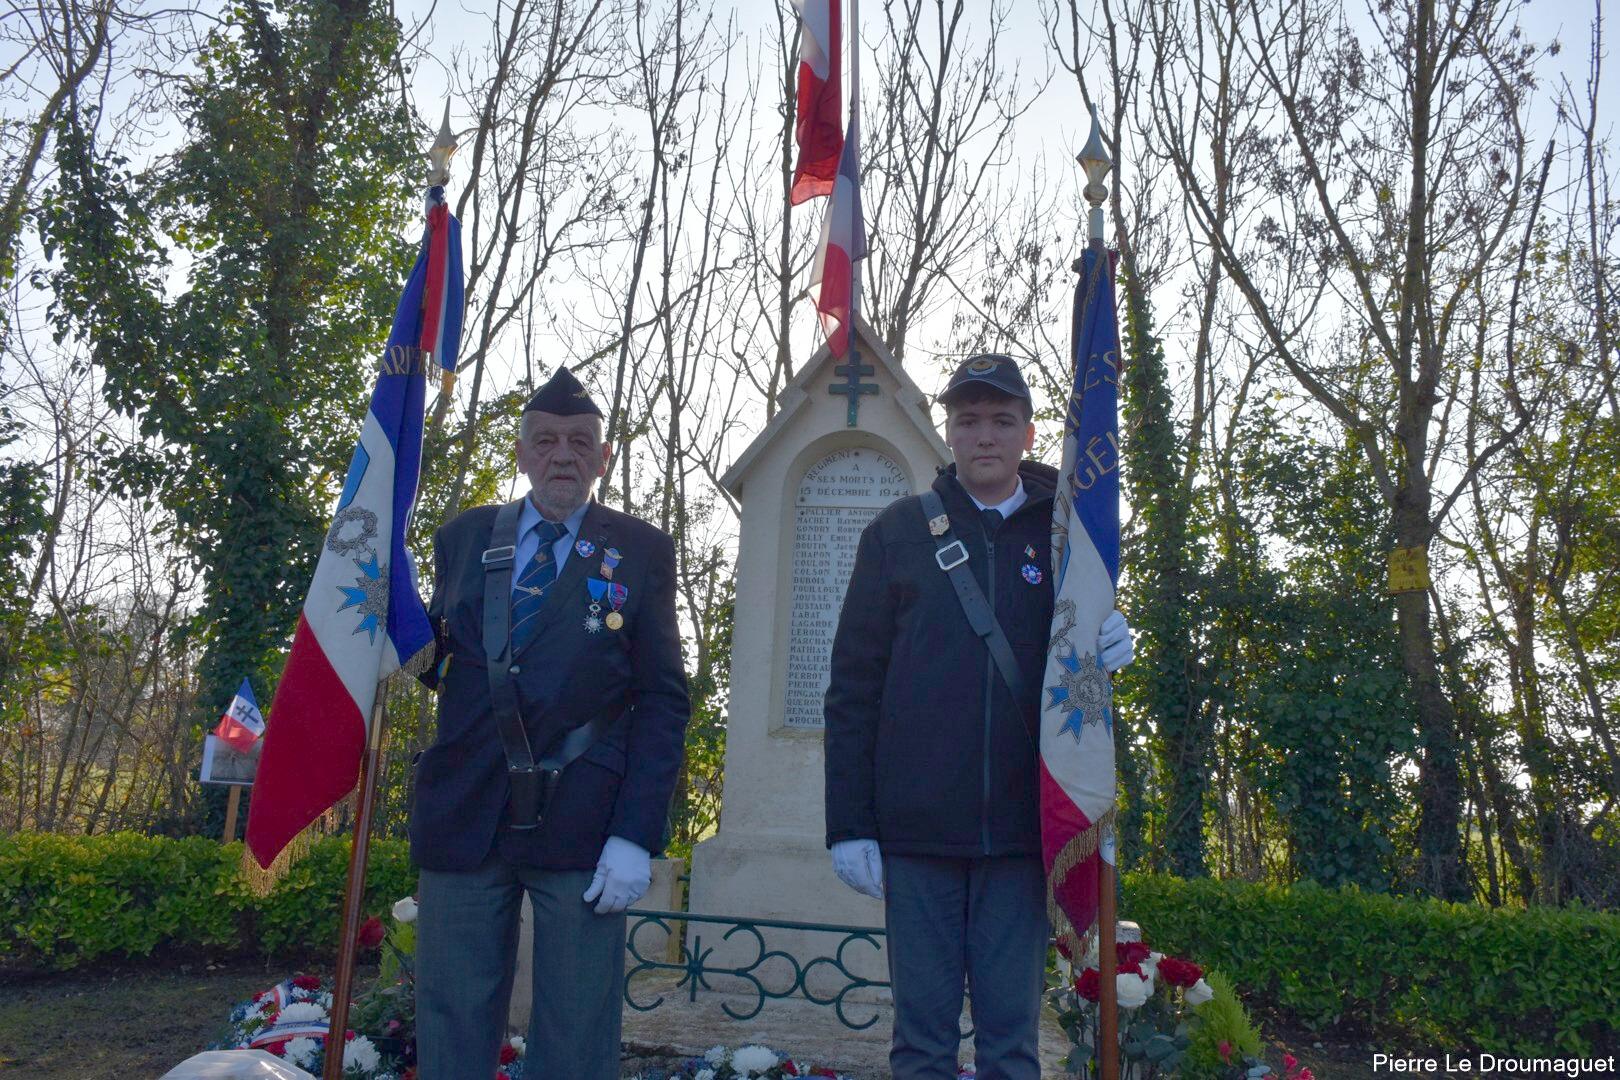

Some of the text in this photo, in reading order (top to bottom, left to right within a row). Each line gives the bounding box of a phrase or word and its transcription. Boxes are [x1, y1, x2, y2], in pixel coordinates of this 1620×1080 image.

[877, 455, 905, 482] FOCH
[817, 475, 896, 485] SES MORTS DU
[879, 488, 909, 496] 1944
[806, 509, 841, 517] PALLIER
[791, 629, 826, 637] LEROUX
[789, 655, 828, 663] PALLIER
